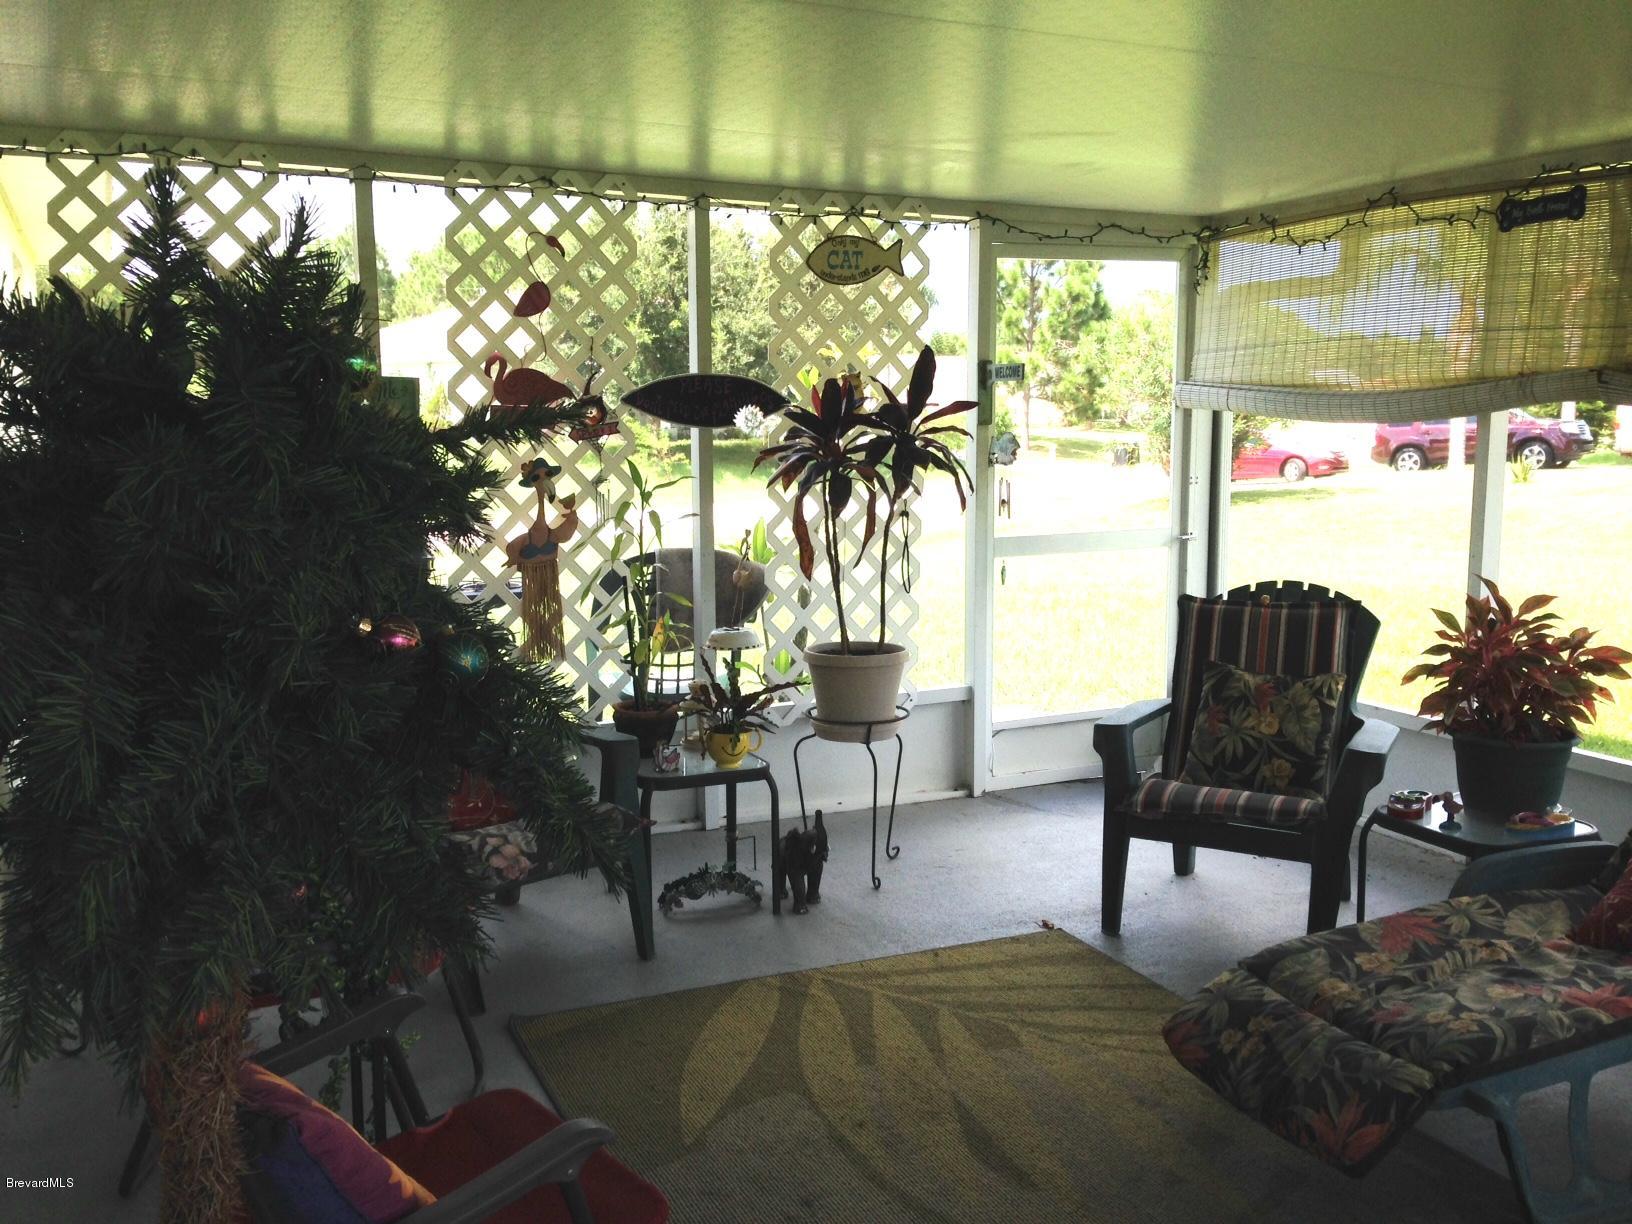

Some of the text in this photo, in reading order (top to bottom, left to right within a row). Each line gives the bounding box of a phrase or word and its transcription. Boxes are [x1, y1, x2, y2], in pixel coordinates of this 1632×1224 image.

[827, 249, 864, 270] CAT
[994, 365, 1021, 379] WELCOME
[680, 376, 733, 396] PLEASE
